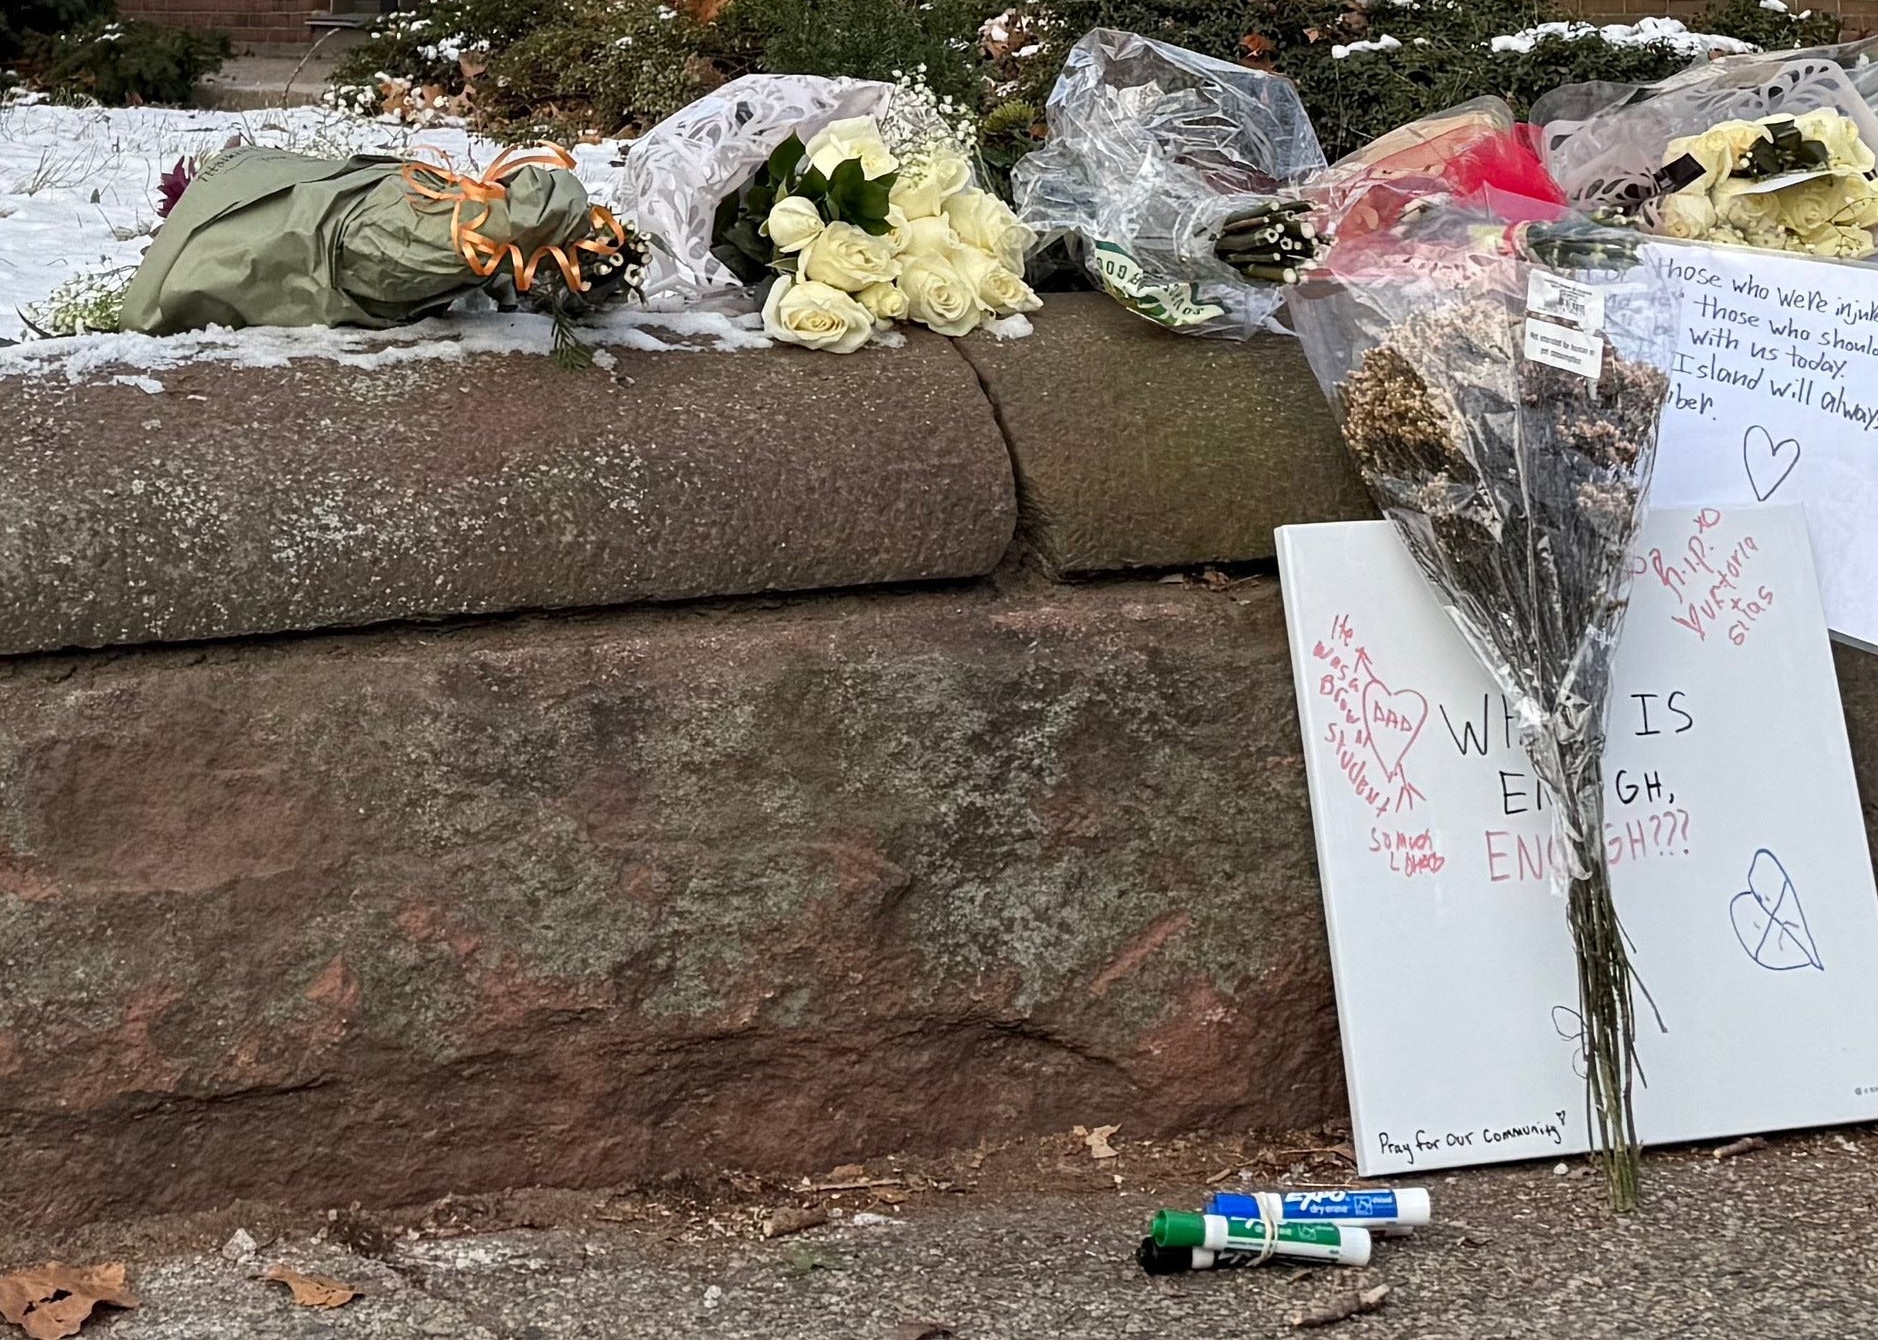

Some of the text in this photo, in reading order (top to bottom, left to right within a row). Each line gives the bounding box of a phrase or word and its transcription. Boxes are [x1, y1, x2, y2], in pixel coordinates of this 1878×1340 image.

[1732, 274, 1770, 301] who
[1693, 293, 1760, 328] those
[1768, 318, 1811, 341] who
[1689, 327, 1740, 351] with
[1750, 340, 1779, 362] us
[1785, 344, 1848, 380] today.
[1671, 351, 1766, 391] Island
[1770, 370, 1814, 406] will
[1373, 699, 1414, 733] DAD
[1439, 690, 1694, 756] WH IS
[1498, 769, 1676, 815] ENGH,
[1378, 1131, 1415, 1165] Pray
[1414, 1129, 1441, 1152] for
